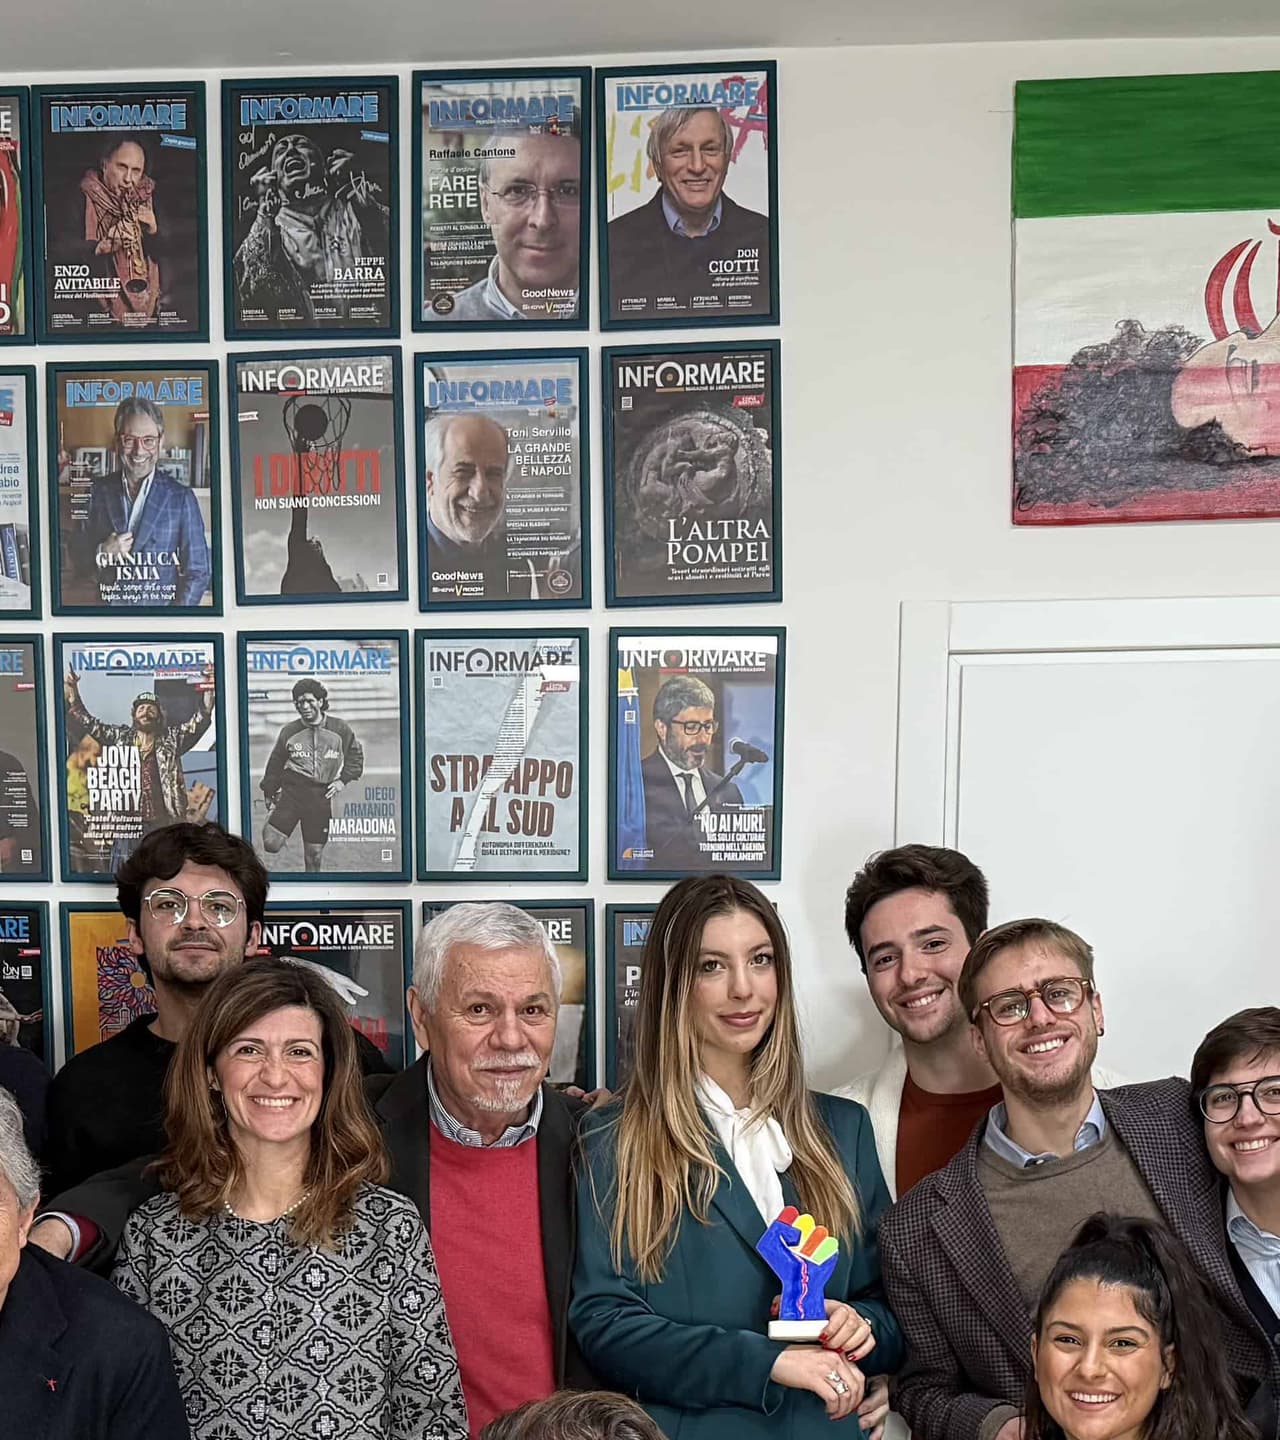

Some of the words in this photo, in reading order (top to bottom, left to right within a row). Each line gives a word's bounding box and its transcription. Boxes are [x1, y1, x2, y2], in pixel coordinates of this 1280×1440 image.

[617, 81, 759, 111] INFORMARE
[51, 104, 186, 132] INFORMARE
[241, 95, 378, 126] INFORMARE
[429, 95, 575, 128] INFORMARE
[430, 149, 470, 158] Raffaele
[474, 148, 516, 157] Cantone
[429, 175, 478, 191] FARE
[429, 192, 478, 208] RETE
[355, 257, 385, 266] PEPPE
[737, 249, 759, 258] DON
[54, 265, 89, 277] ENZO
[334, 267, 385, 280] BARRA
[708, 260, 759, 272] CIOTTI
[55, 278, 120, 290] AVITABILE
[241, 365, 384, 393] INFORMARE
[619, 361, 765, 388] INFORMARE
[66, 380, 202, 407] INFORMARE
[428, 379, 573, 407] INFORMARE
[506, 428, 529, 438] Toni
[532, 427, 571, 437] Servillo
[507, 444, 521, 453] LA
[525, 443, 571, 453] GRANDE
[516, 455, 571, 465] BELLEZZA
[531, 466, 572, 476] NAPOLI
[255, 499, 276, 510] NON
[279, 497, 309, 509] SIANO
[312, 494, 380, 507] CONCESSIONI
[668, 517, 770, 541] L'ALTRA
[96, 552, 180, 566] GIANLUCA
[667, 541, 768, 564] POMPEI
[116, 566, 160, 580] ISAIA
[72, 649, 206, 671] INFORMARE
[252, 647, 391, 670] INFORMARE
[430, 648, 572, 672] INFORMARE
[623, 650, 766, 667] INFORMARE
[97, 745, 140, 767] JOVA
[87, 767, 141, 789] BEACH
[89, 789, 141, 811] PARTY
[365, 786, 395, 800] DIEGO
[344, 803, 395, 816] ARMANDO
[507, 799, 555, 837] SUD
[329, 818, 396, 834] MARADONA
[719, 814, 731, 832] AI
[264, 922, 394, 945] NFORMARE
